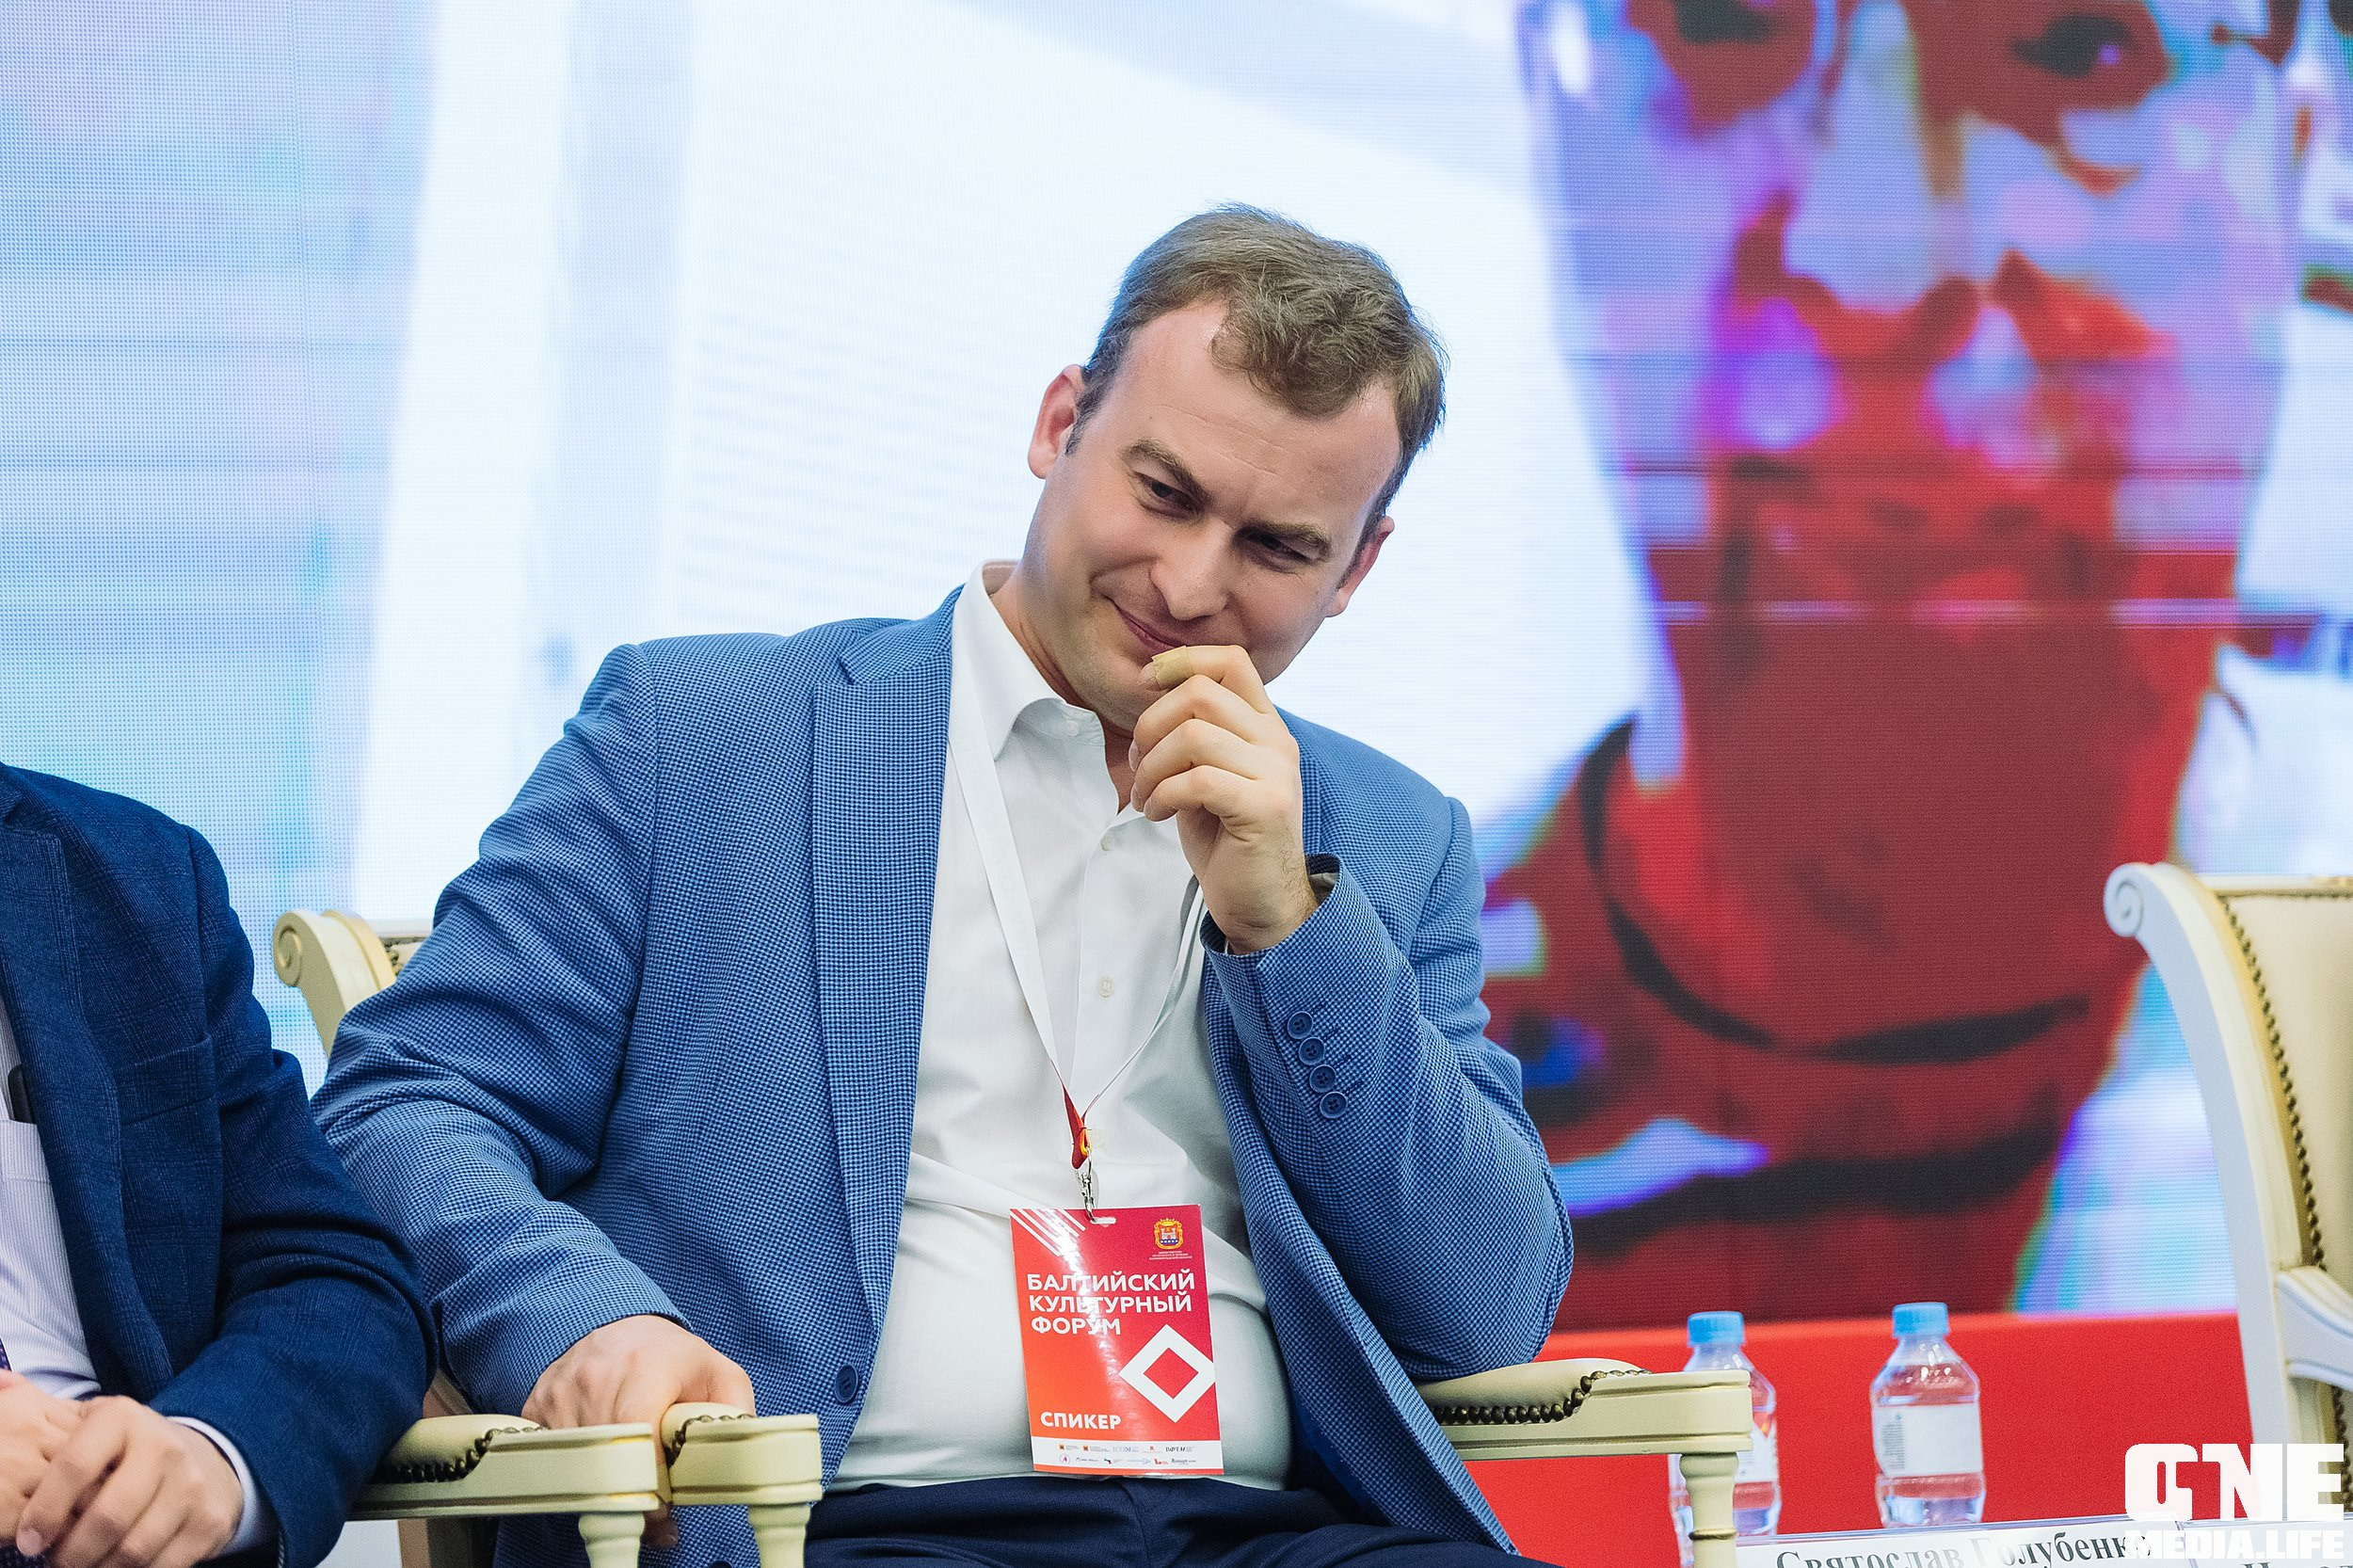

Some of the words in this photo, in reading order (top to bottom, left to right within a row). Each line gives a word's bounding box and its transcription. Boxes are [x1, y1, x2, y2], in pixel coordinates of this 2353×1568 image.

[1027, 1268, 1194, 1291] БАЛТИЙСКИЙ
[1029, 1290, 1192, 1313] КУЛЬТУРНЫЙ
[1031, 1316, 1121, 1335] ФОРУМ
[1040, 1412, 1121, 1430] СПИКЕР
